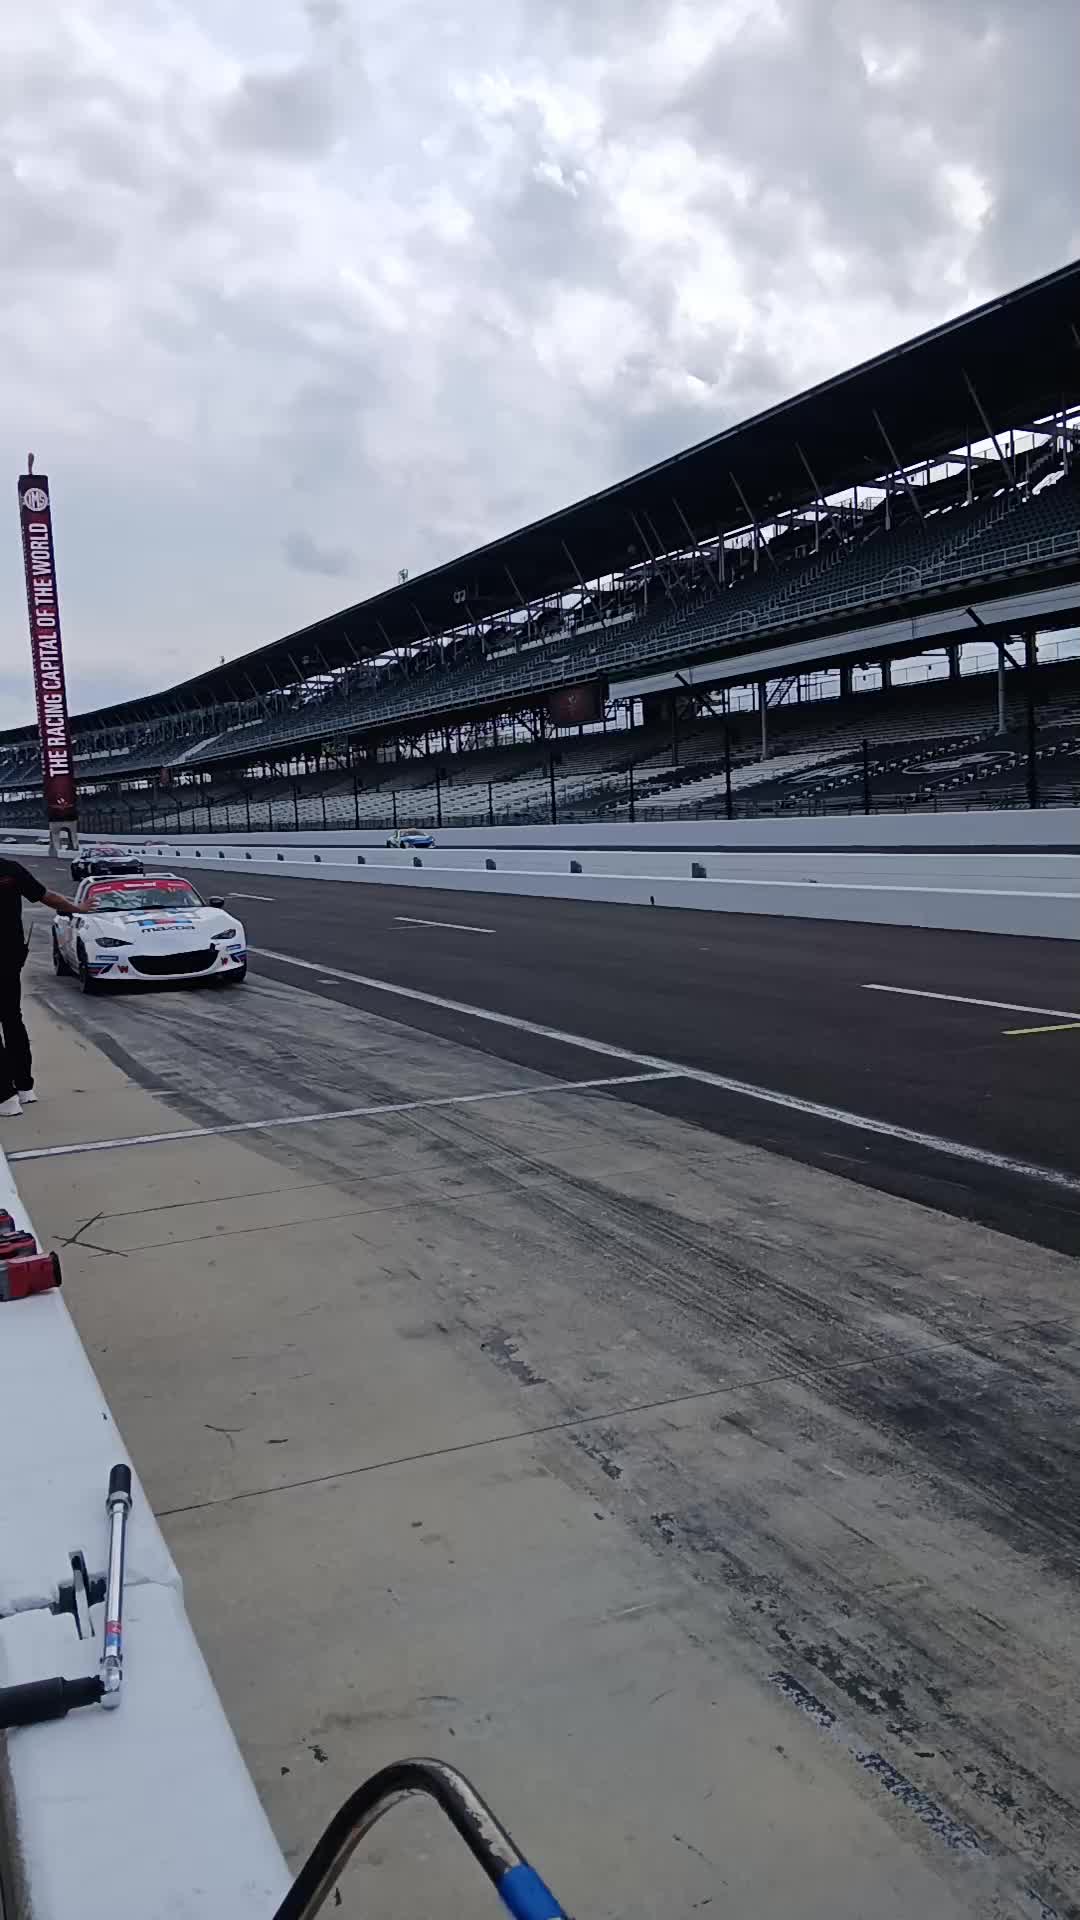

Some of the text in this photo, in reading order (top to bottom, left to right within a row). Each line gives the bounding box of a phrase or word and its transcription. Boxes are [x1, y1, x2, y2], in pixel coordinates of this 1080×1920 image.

[29, 523, 51, 576] WORLD
[33, 579, 54, 606] THE
[36, 608, 56, 626] OF
[38, 632, 61, 689] CAPITAL
[44, 694, 66, 746] RACING
[48, 750, 69, 777] THE
